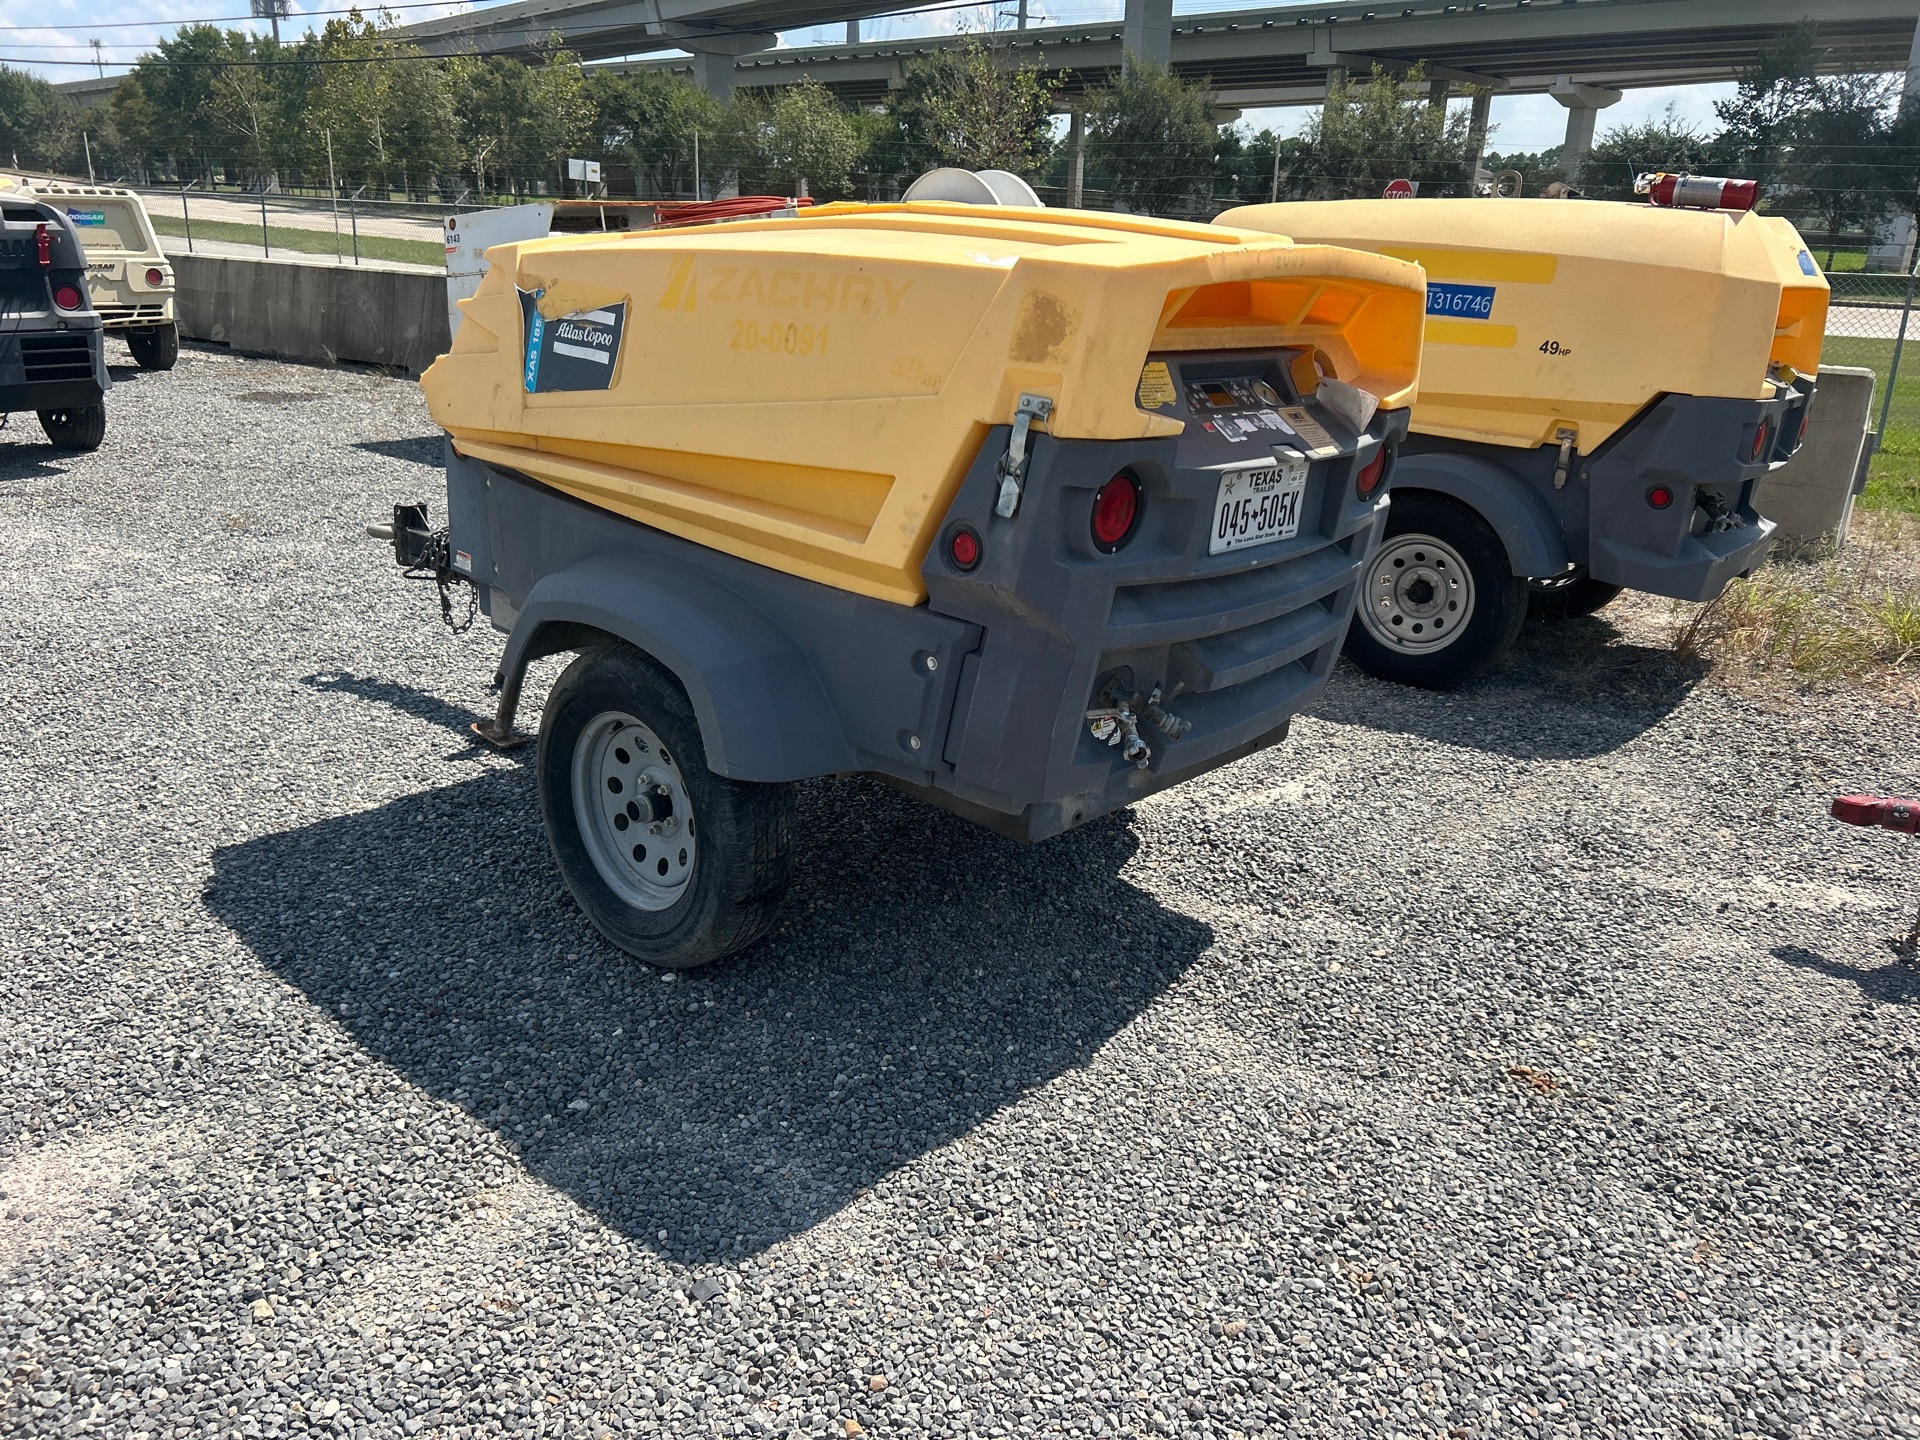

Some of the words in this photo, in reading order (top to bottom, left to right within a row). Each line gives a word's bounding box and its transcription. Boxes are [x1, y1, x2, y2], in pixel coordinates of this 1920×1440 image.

[1386, 190, 1411, 198] STOP
[446, 234, 461, 244] 6143
[706, 265, 917, 317] ZACHRY
[1427, 292, 1491, 313] 1316746
[532, 319, 542, 343] 185
[730, 318, 830, 357] 20-0091
[527, 350, 538, 382] XAS
[1249, 469, 1283, 487] TEXAS
[1253, 485, 1275, 494] TRAILER
